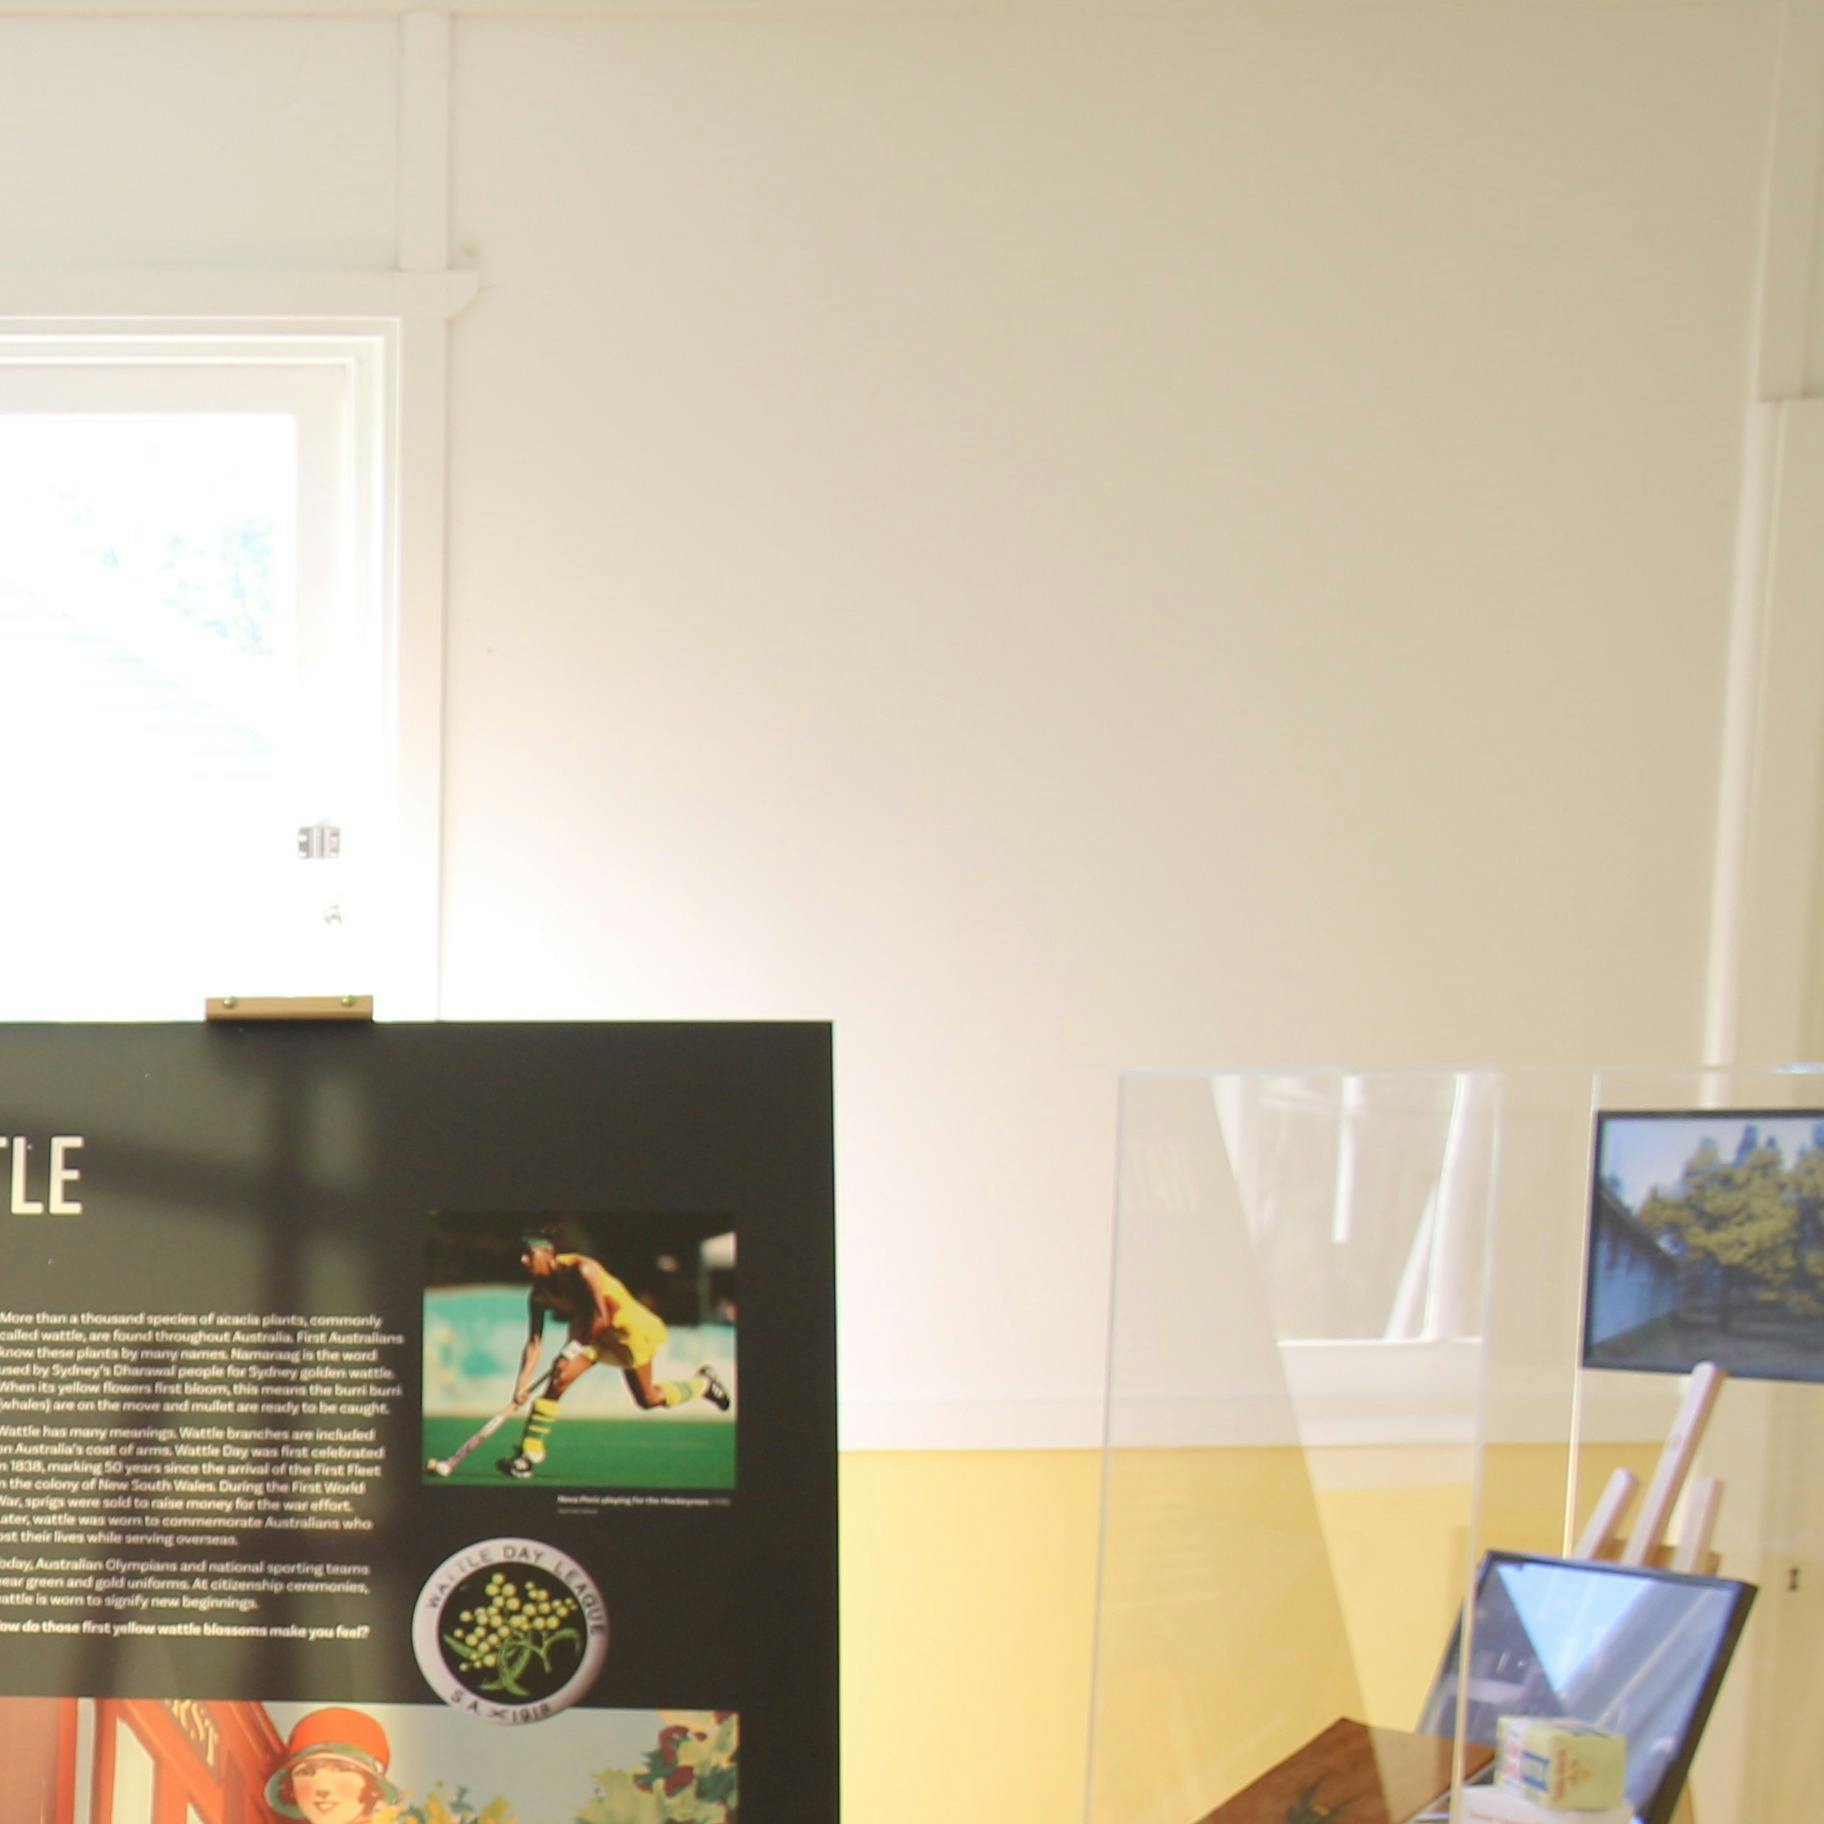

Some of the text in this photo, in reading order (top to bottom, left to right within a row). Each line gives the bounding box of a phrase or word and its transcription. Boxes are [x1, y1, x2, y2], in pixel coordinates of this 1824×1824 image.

[0, 1312, 381, 1328] More than a thousand species of acacia plants, commonly
[43, 1425, 67, 1437] has
[70, 1429, 107, 1440] many
[179, 1427, 225, 1439] Wattle
[227, 1427, 289, 1439] branches
[292, 1431, 314, 1440] are
[316, 1429, 375, 1441] included
[502, 1545, 545, 1564] DAY
[22, 1620, 40, 1632] do
[42, 1621, 80, 1633] those
[83, 1621, 110, 1633] first
[113, 1622, 155, 1636] yellow
[158, 1623, 201, 1635] wattle
[203, 1623, 267, 1636] blossoms
[270, 1625, 307, 1637] make
[309, 1628, 334, 1640] you
[336, 1625, 369, 1638] feel?
